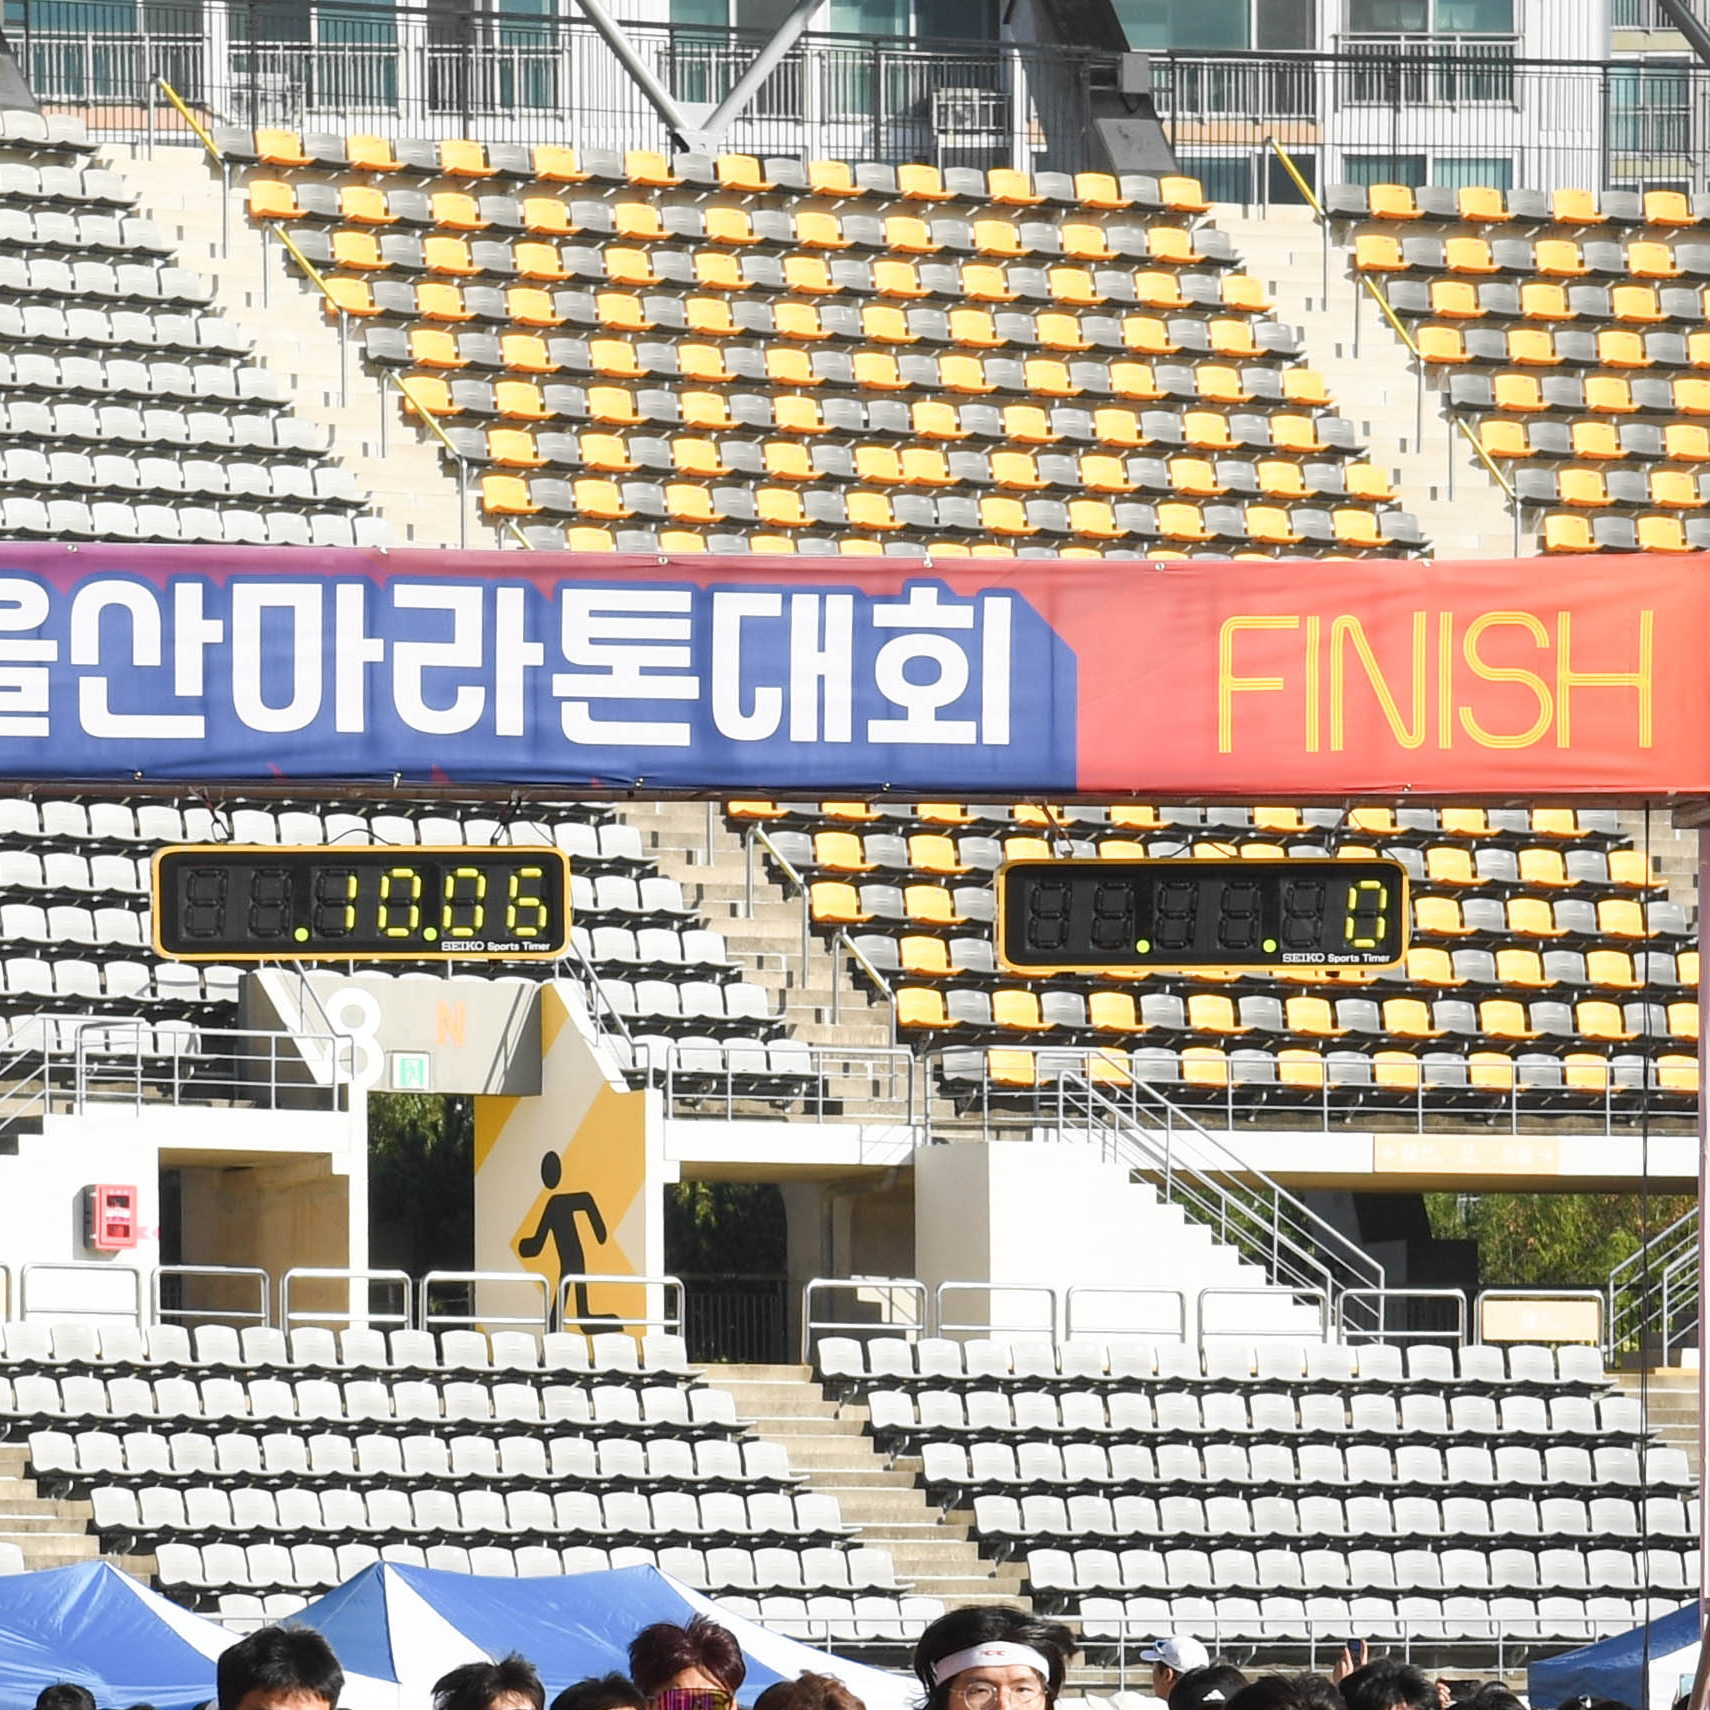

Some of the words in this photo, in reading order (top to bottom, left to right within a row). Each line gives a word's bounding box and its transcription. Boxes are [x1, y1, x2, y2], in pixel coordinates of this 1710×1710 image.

[1218, 611, 1654, 753] FINISH
[441, 941, 484, 951] SEIKO
[487, 941, 520, 952] Sports
[522, 941, 551, 951] Timer
[1282, 953, 1325, 963] SEIKO
[1327, 953, 1360, 964] Sports
[1362, 953, 1391, 963] Timer
[327, 987, 383, 1088] 8
[435, 1003, 465, 1046] N
